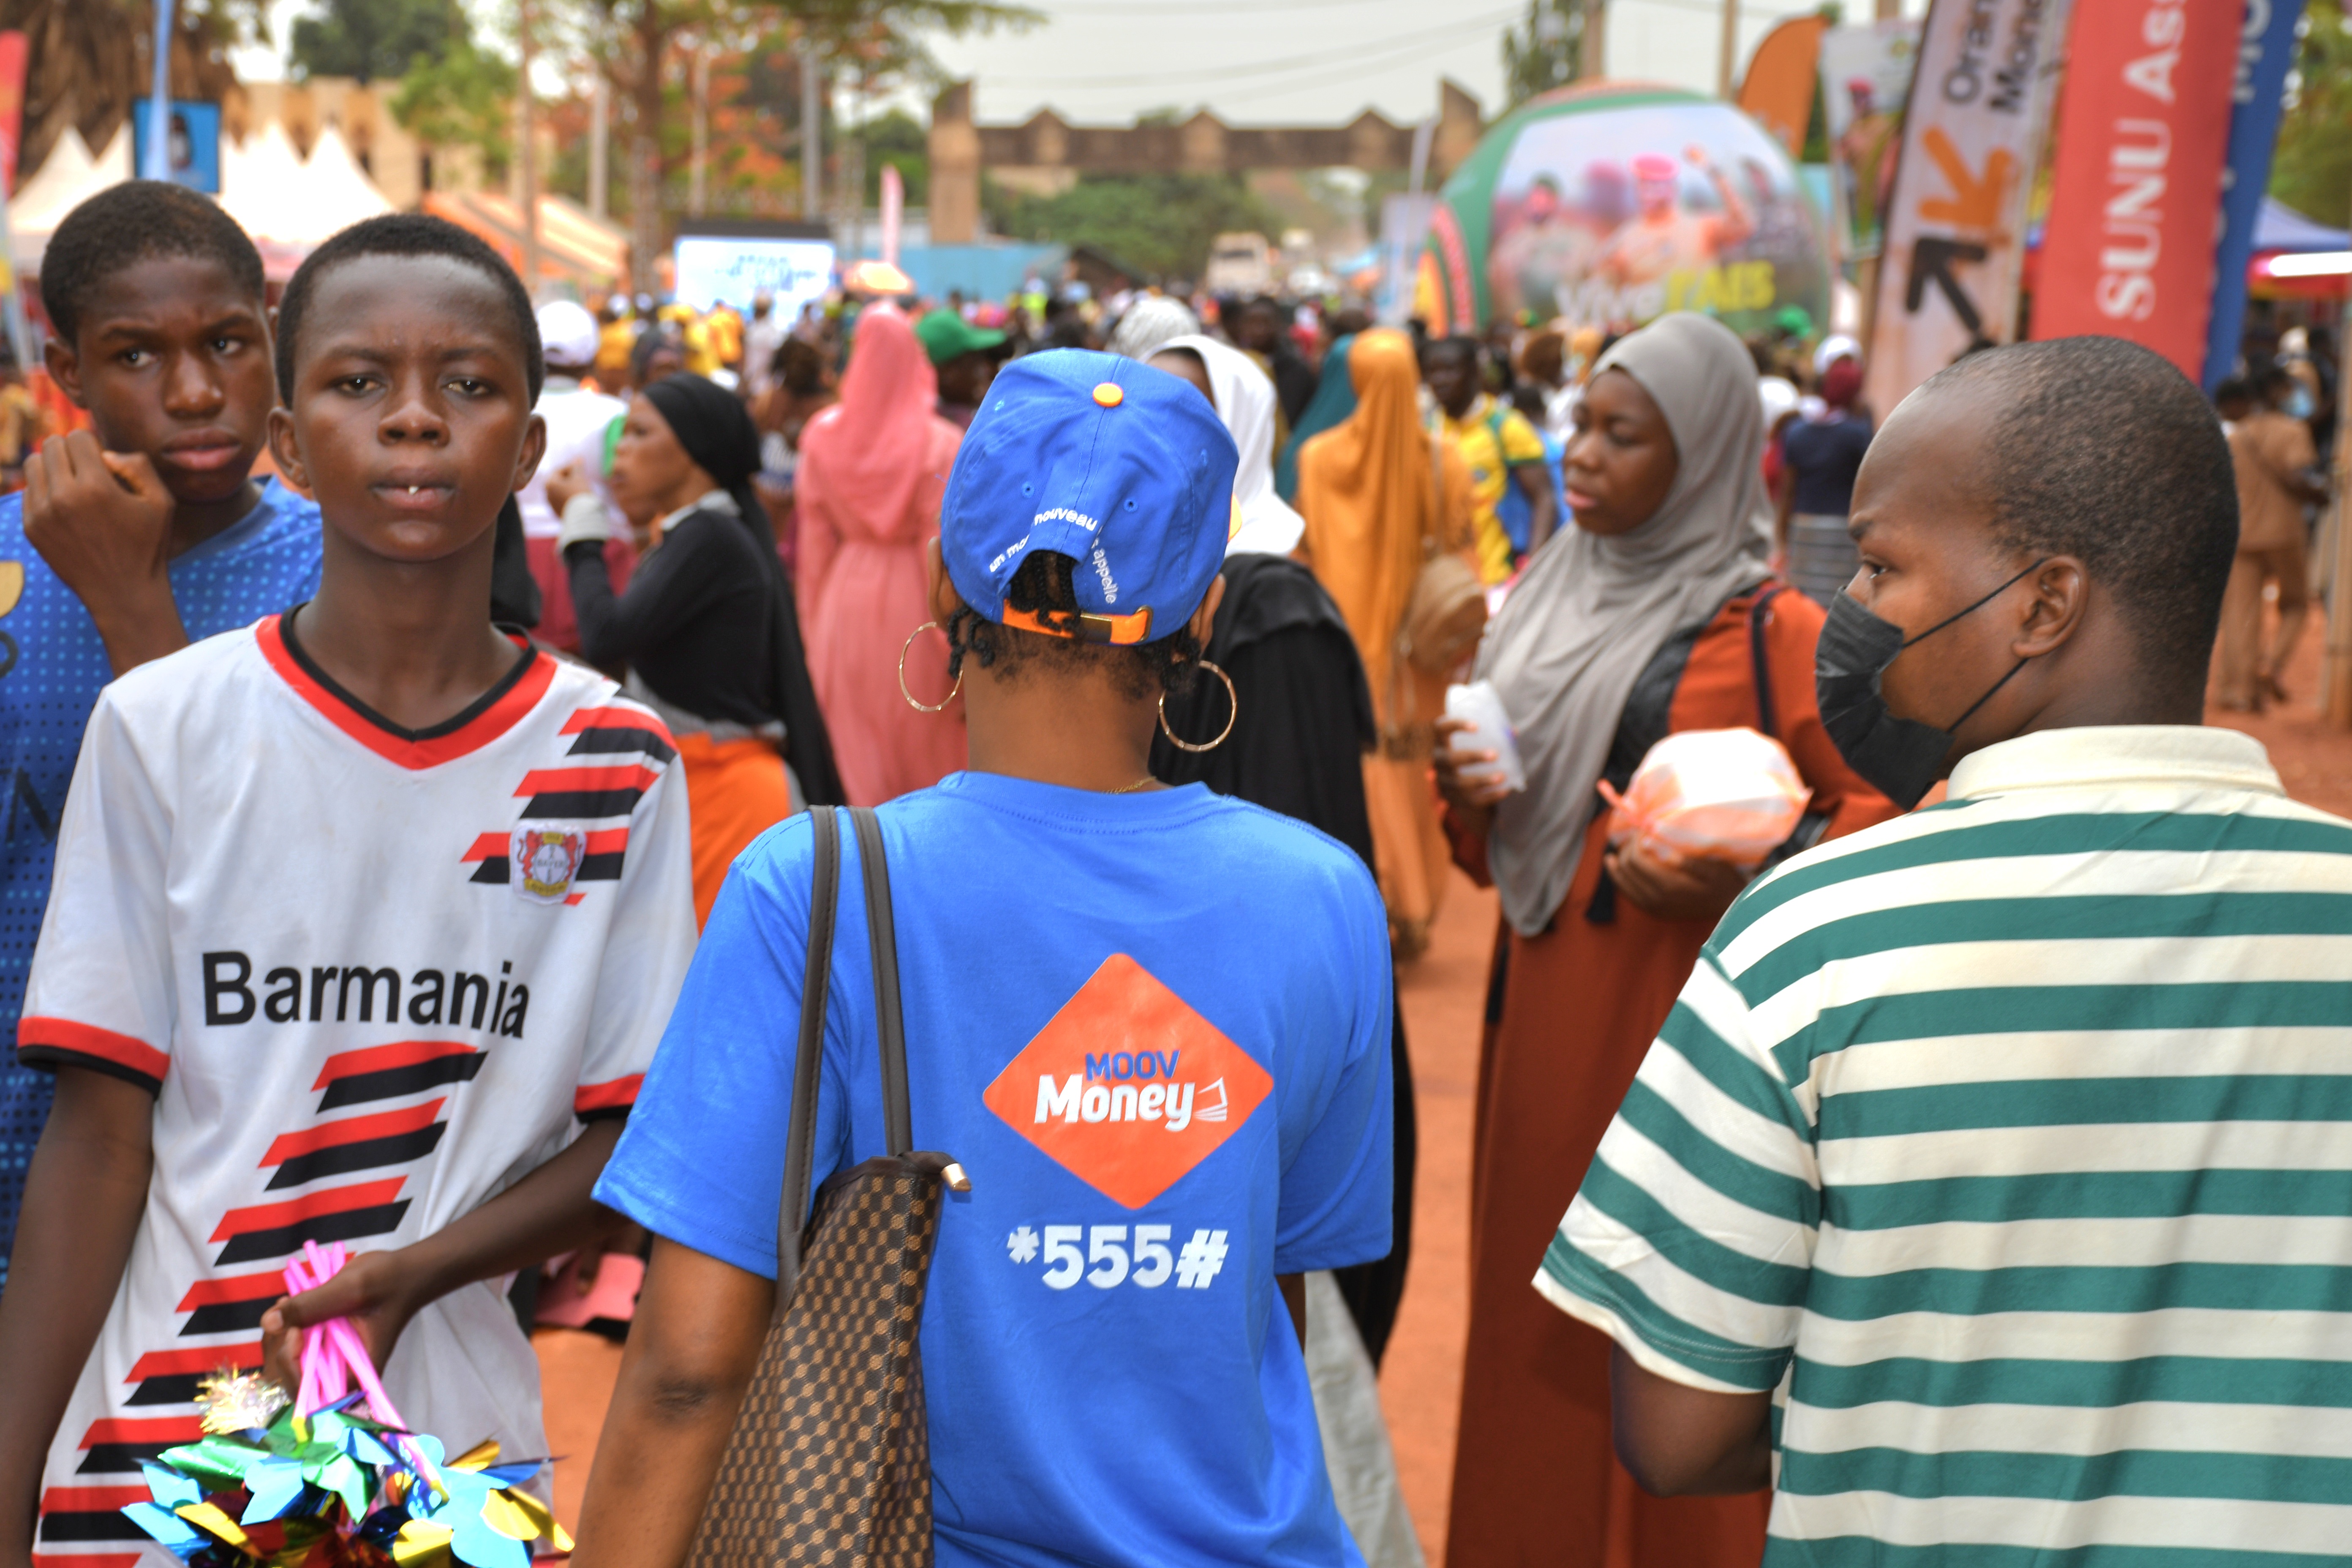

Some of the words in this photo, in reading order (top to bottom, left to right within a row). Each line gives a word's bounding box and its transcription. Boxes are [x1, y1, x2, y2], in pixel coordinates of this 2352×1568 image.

[2123, 0, 2187, 104] As
[2096, 120, 2171, 321] SUNU
[989, 554, 1006, 572] un
[1034, 508, 1097, 531] nouveau
[1092, 548, 1118, 604] appelle
[202, 951, 530, 1039] Barmania
[1034, 1074, 1195, 1132] Money
[1085, 1050, 1181, 1081] MOOV
